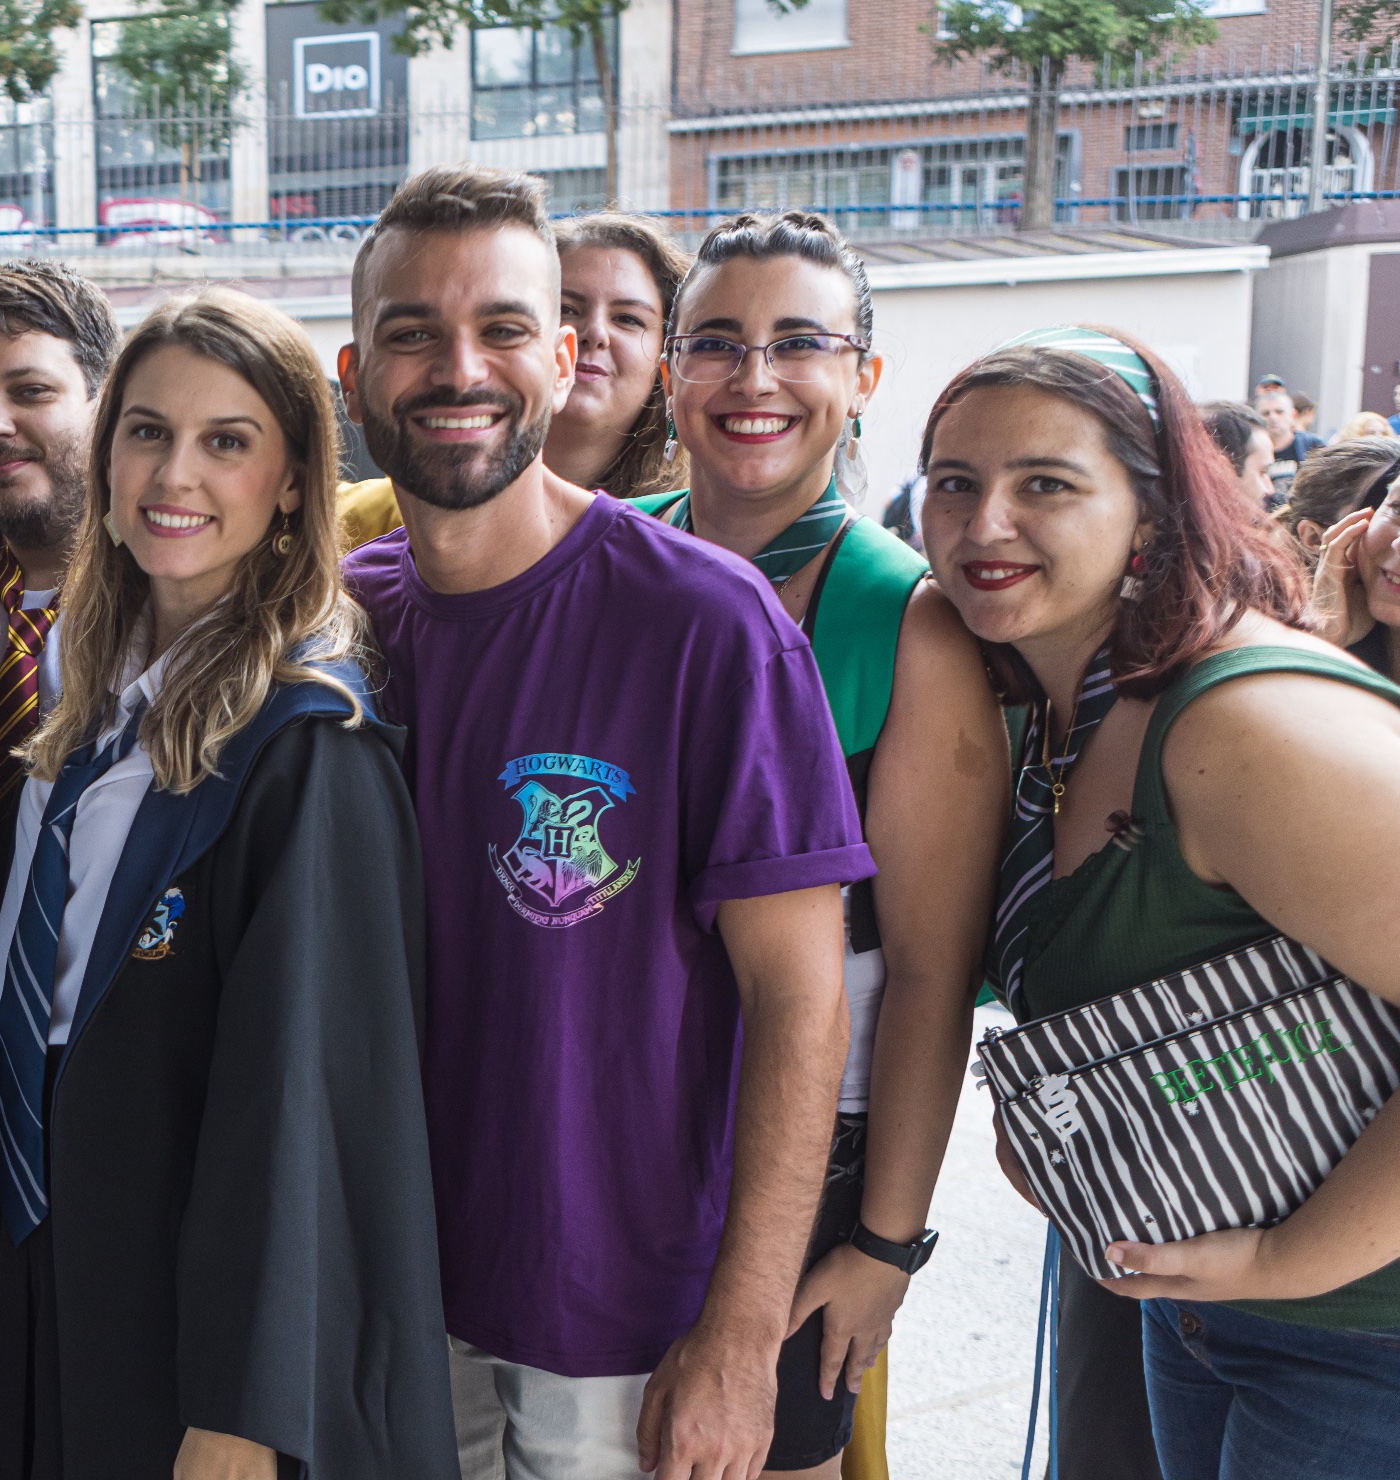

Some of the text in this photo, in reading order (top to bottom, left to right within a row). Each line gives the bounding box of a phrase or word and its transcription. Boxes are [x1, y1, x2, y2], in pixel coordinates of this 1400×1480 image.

[514, 756, 625, 784] HOGWARTS
[547, 829, 571, 855] H
[496, 867, 515, 892] DRACO
[1150, 1019, 1345, 1105] BEETLEJUICE
